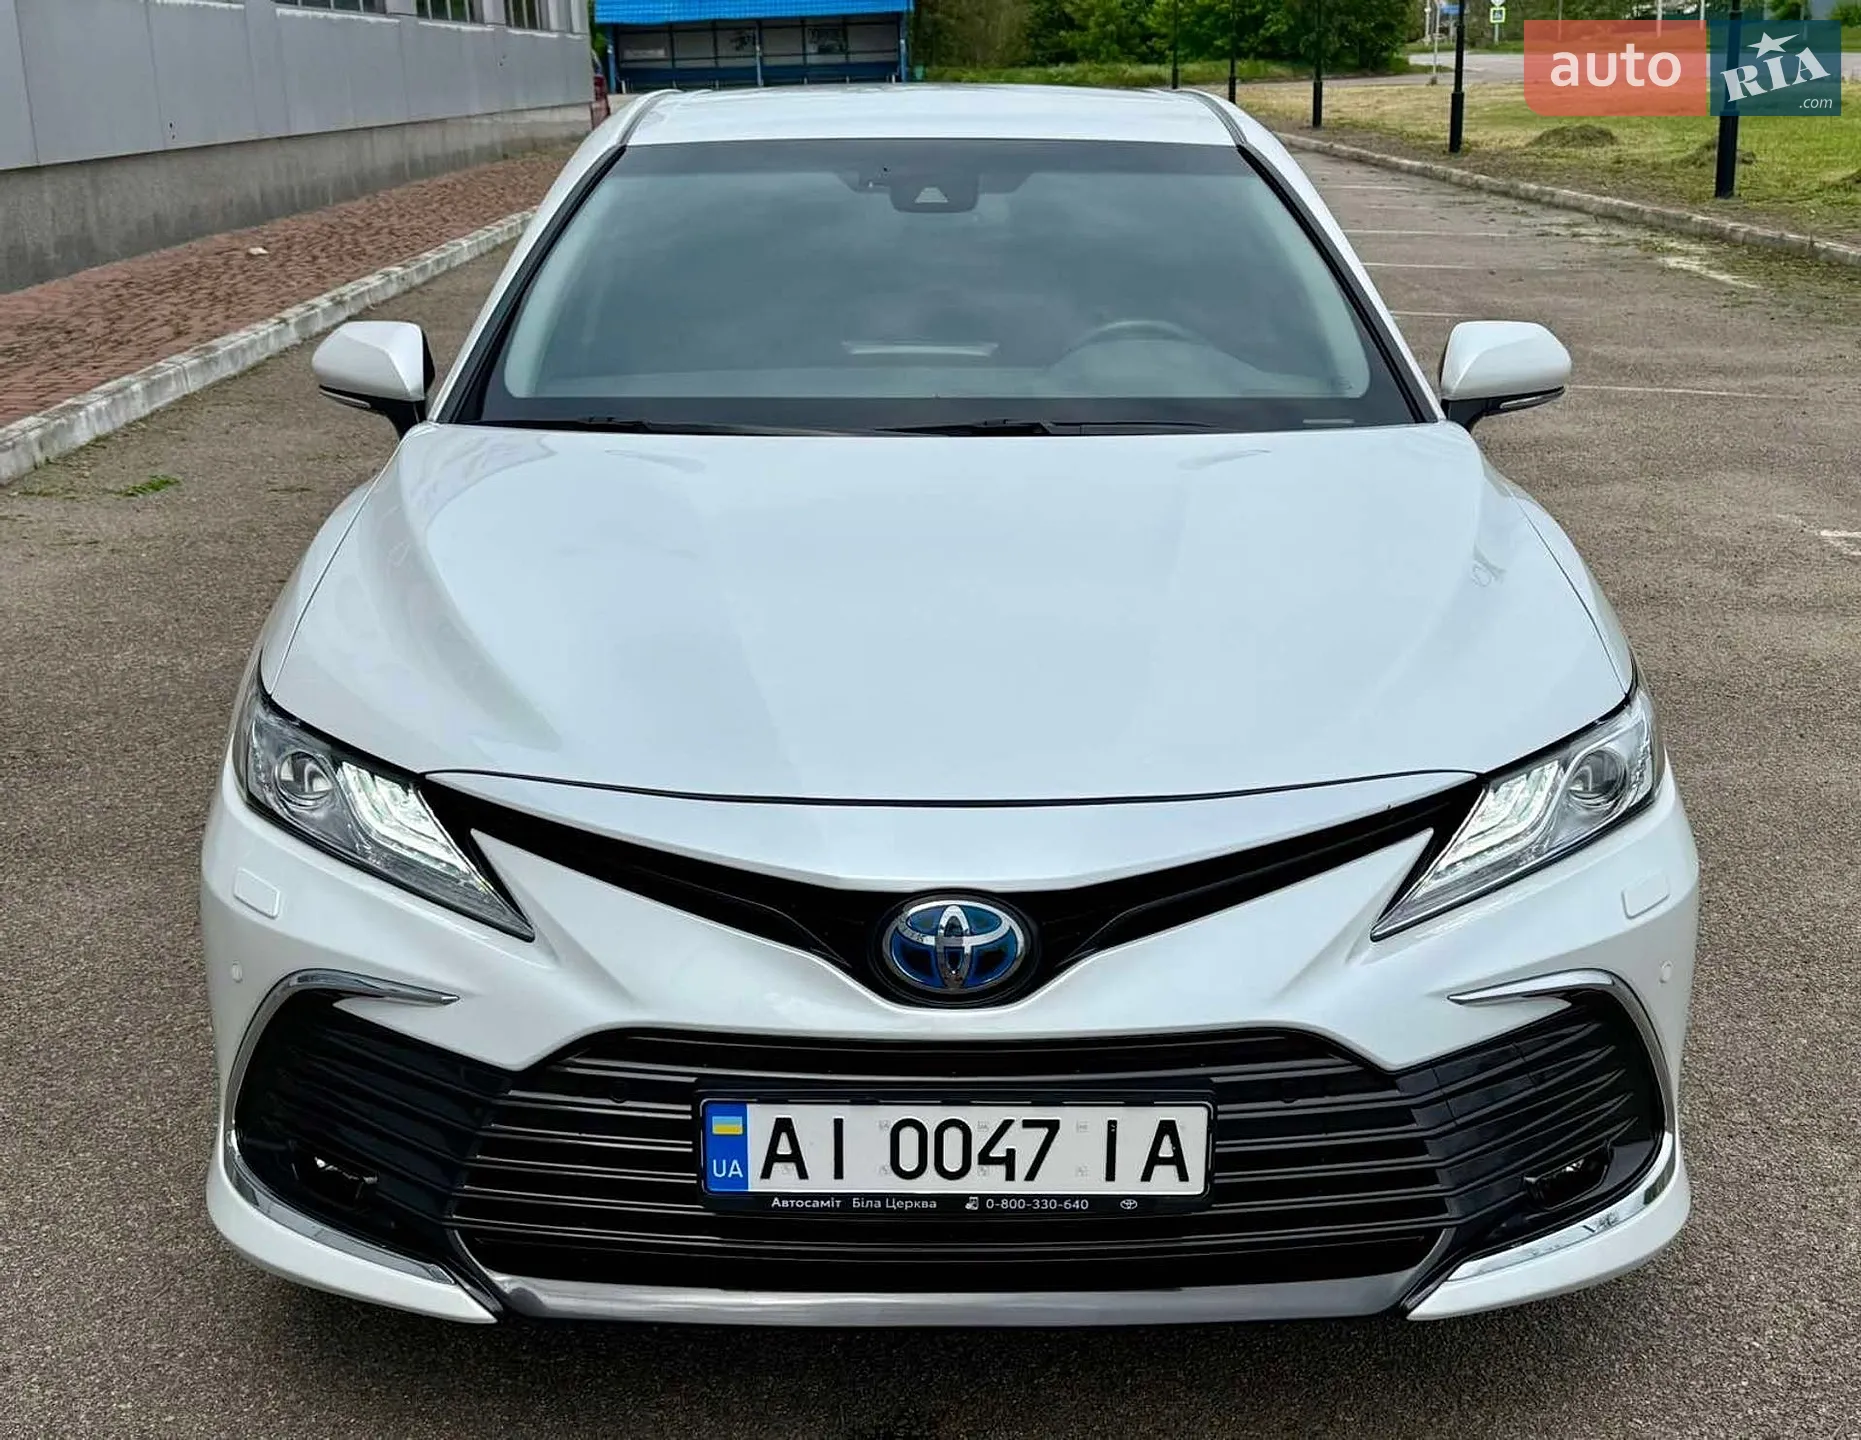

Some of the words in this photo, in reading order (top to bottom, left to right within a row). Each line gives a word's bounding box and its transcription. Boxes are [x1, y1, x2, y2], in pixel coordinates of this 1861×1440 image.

[760, 1117, 844, 1180] AI
[890, 1118, 1061, 1182] 0047
[1105, 1119, 1190, 1182] IA
[712, 1159, 744, 1179] UA
[771, 1196, 842, 1210] Автосаміт
[851, 1196, 882, 1210] Біла
[884, 1197, 938, 1212] Церква
[985, 1197, 1090, 1211] 0-800-330-640
